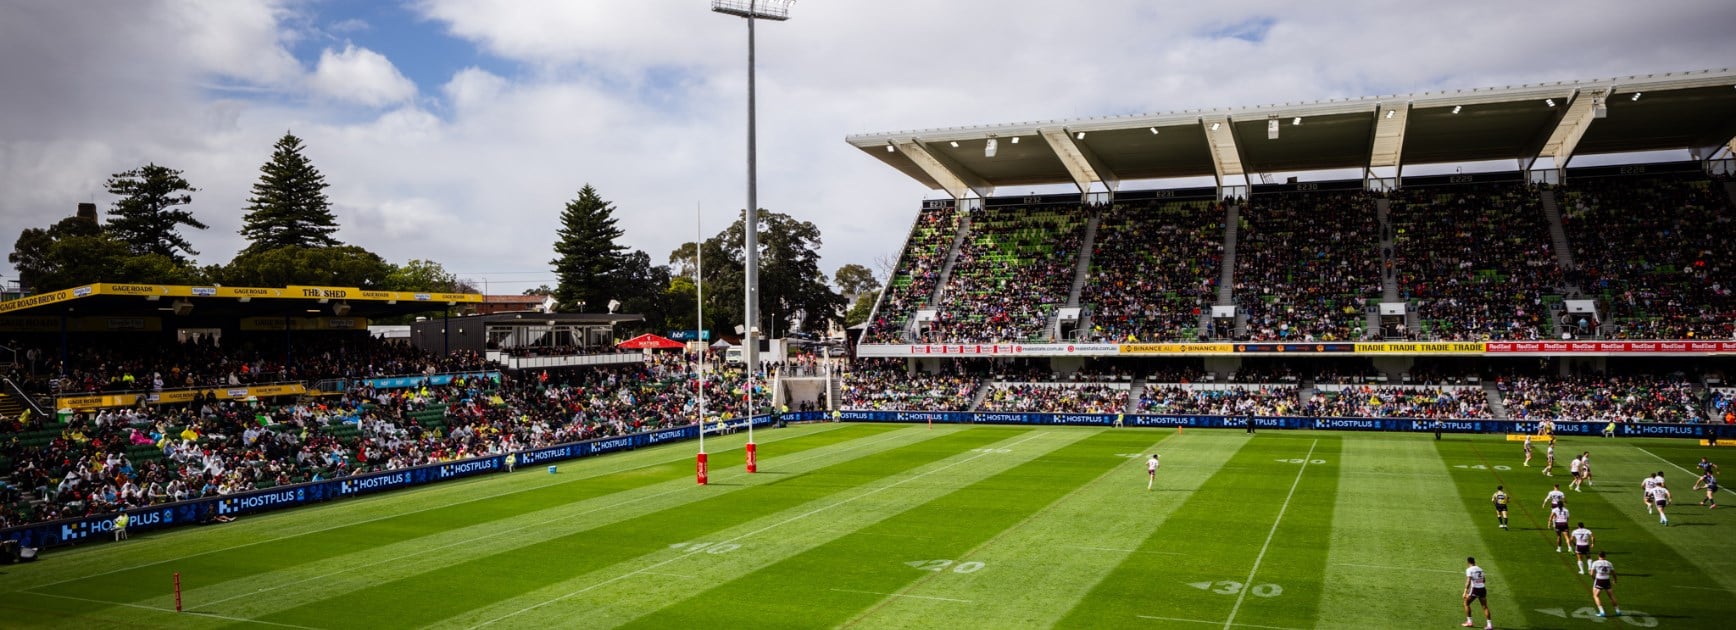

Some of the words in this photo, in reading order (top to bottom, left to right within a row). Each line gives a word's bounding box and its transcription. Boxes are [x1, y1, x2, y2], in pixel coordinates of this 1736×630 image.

[1297, 183, 1318, 191] E230
[302, 288, 320, 297] THE
[323, 290, 346, 298] SHED
[0, 302, 17, 312] GAGE
[17, 297, 38, 308] ROADS
[38, 293, 56, 304] BREW
[56, 291, 67, 301] CO
[671, 331, 685, 339] hbf
[1150, 417, 1188, 425] HOSTPLUS
[1238, 418, 1277, 426] HOTPLUS
[1331, 420, 1372, 428] HOSTPLUS
[1429, 421, 1472, 430] HSTPLUS
[658, 430, 680, 440] HOSTPLUS
[1642, 426, 1692, 434] HOSTPLUS
[601, 438, 628, 450] HOSTPLUS
[534, 448, 565, 460] HOSTPLUS
[455, 460, 491, 474] HOSTPLUS
[359, 474, 403, 489] HOSTPLUS
[240, 491, 295, 509] HOSTPLUS
[91, 512, 160, 534] HOPLUS
[917, 559, 986, 574] 20
[1212, 580, 1284, 598] 30
